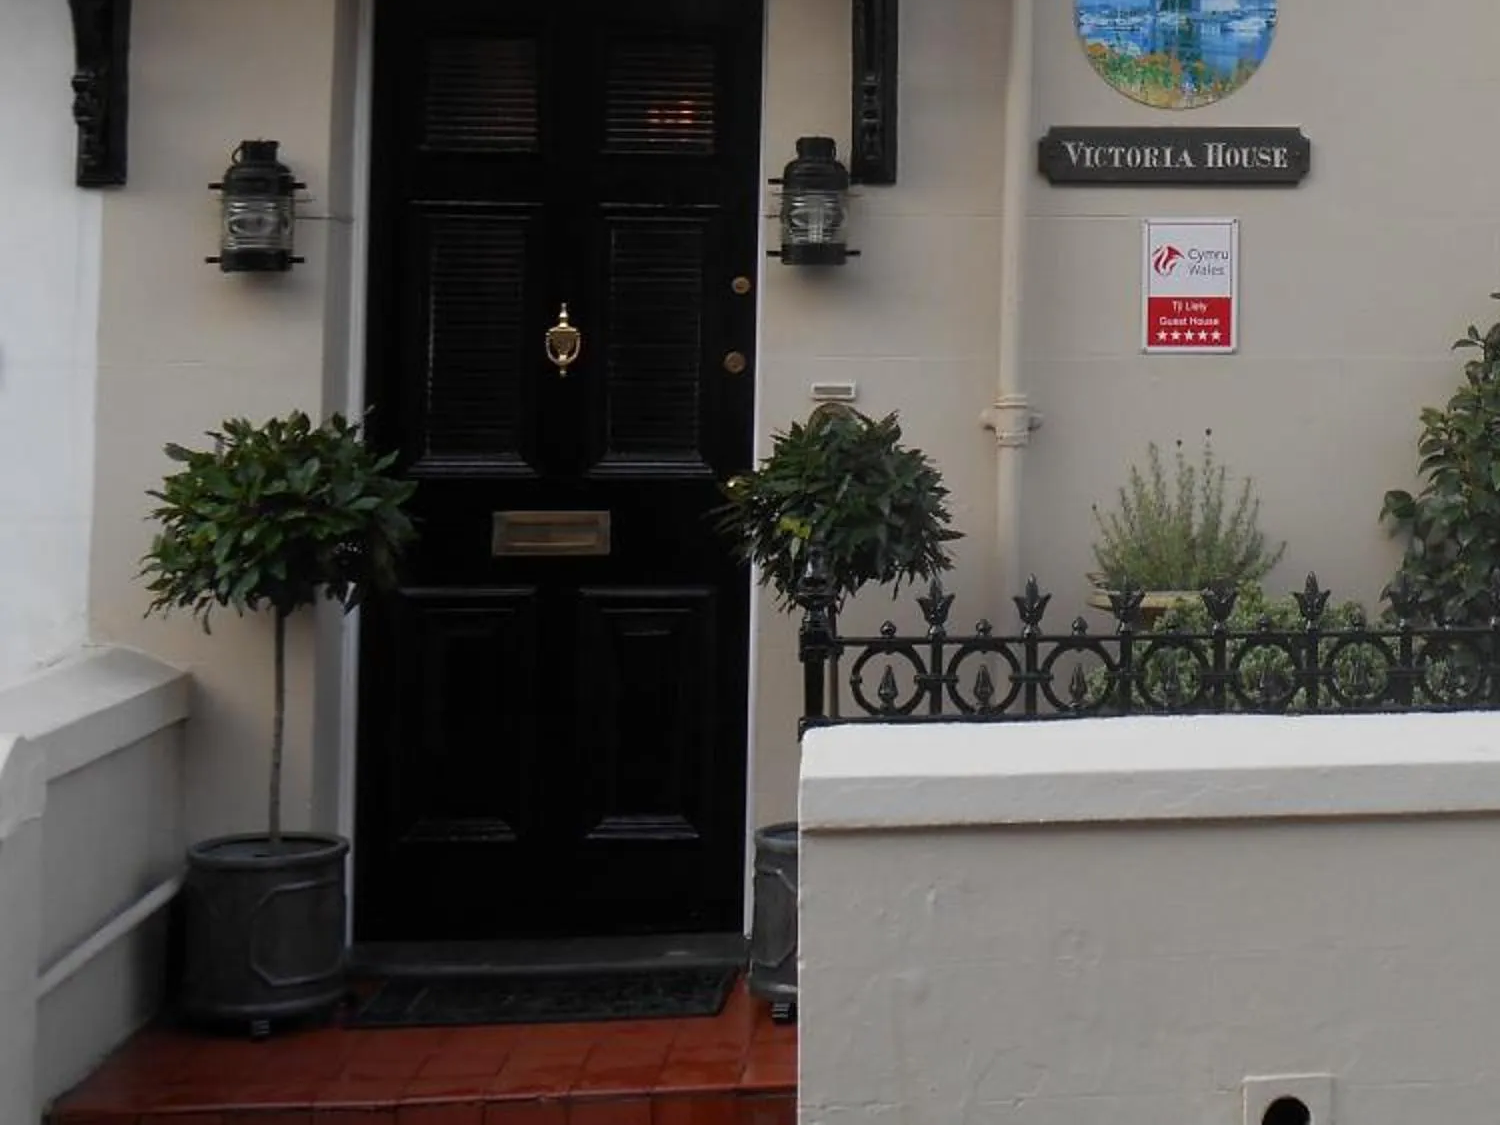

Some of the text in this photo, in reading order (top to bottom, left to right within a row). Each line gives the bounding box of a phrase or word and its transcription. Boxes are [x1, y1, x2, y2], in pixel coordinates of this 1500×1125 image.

[1061, 141, 1288, 168] VICTORIA HOUSE
[1187, 248, 1229, 263] Cymru
[1187, 264, 1225, 276] Wales
[1159, 317, 1219, 326] Guest House
